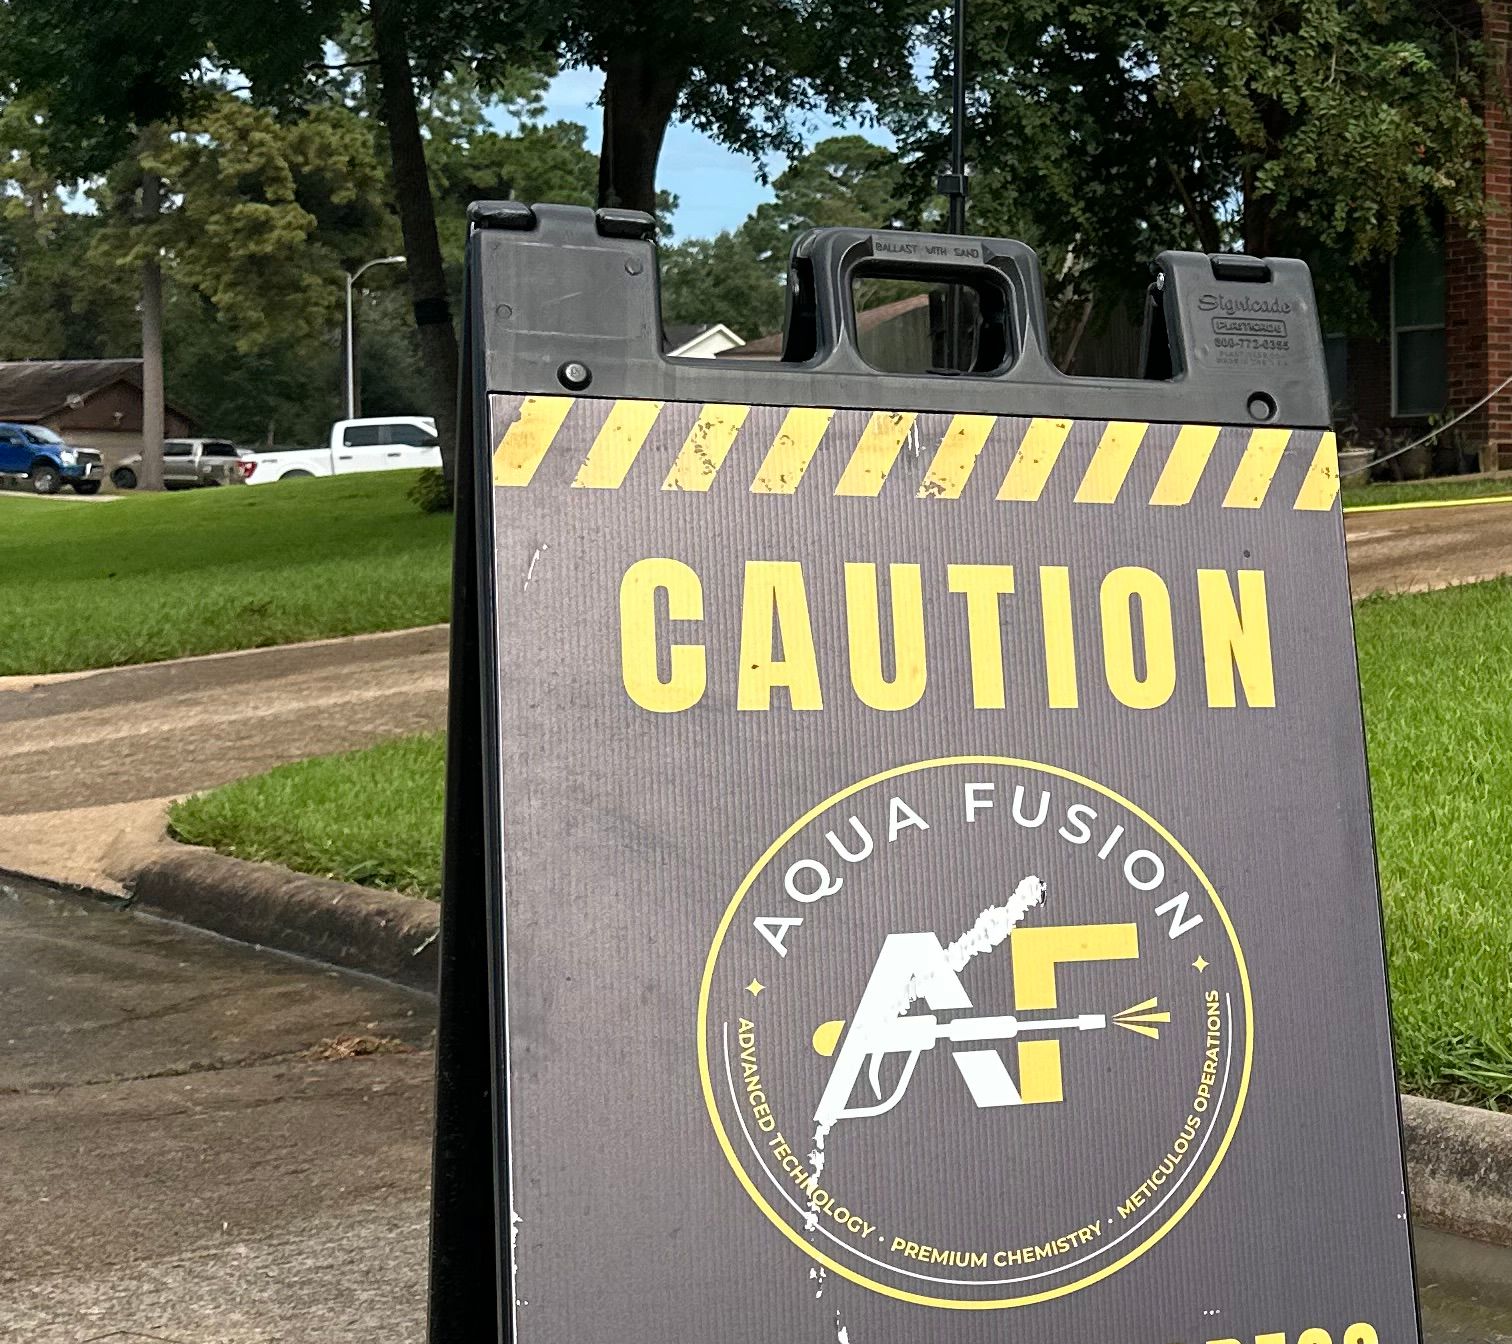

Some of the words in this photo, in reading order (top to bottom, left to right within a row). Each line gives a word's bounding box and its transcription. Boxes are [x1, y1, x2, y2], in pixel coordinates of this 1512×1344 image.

[875, 242, 918, 254] BALLAST
[1197, 294, 1291, 315] Signicade
[620, 557, 1276, 714] CAUTION
[752, 796, 931, 959] AQUA
[964, 782, 1204, 940] FUSION
[738, 1017, 776, 1132] ADVANCED
[768, 1131, 877, 1239] TECHNOLOGY
[890, 1236, 988, 1268] PREMIUM
[993, 1219, 1102, 1267] CHEMISTRY
[1116, 1114, 1201, 1219] METICULOUS
[1193, 989, 1221, 1112] OPERATIONS
